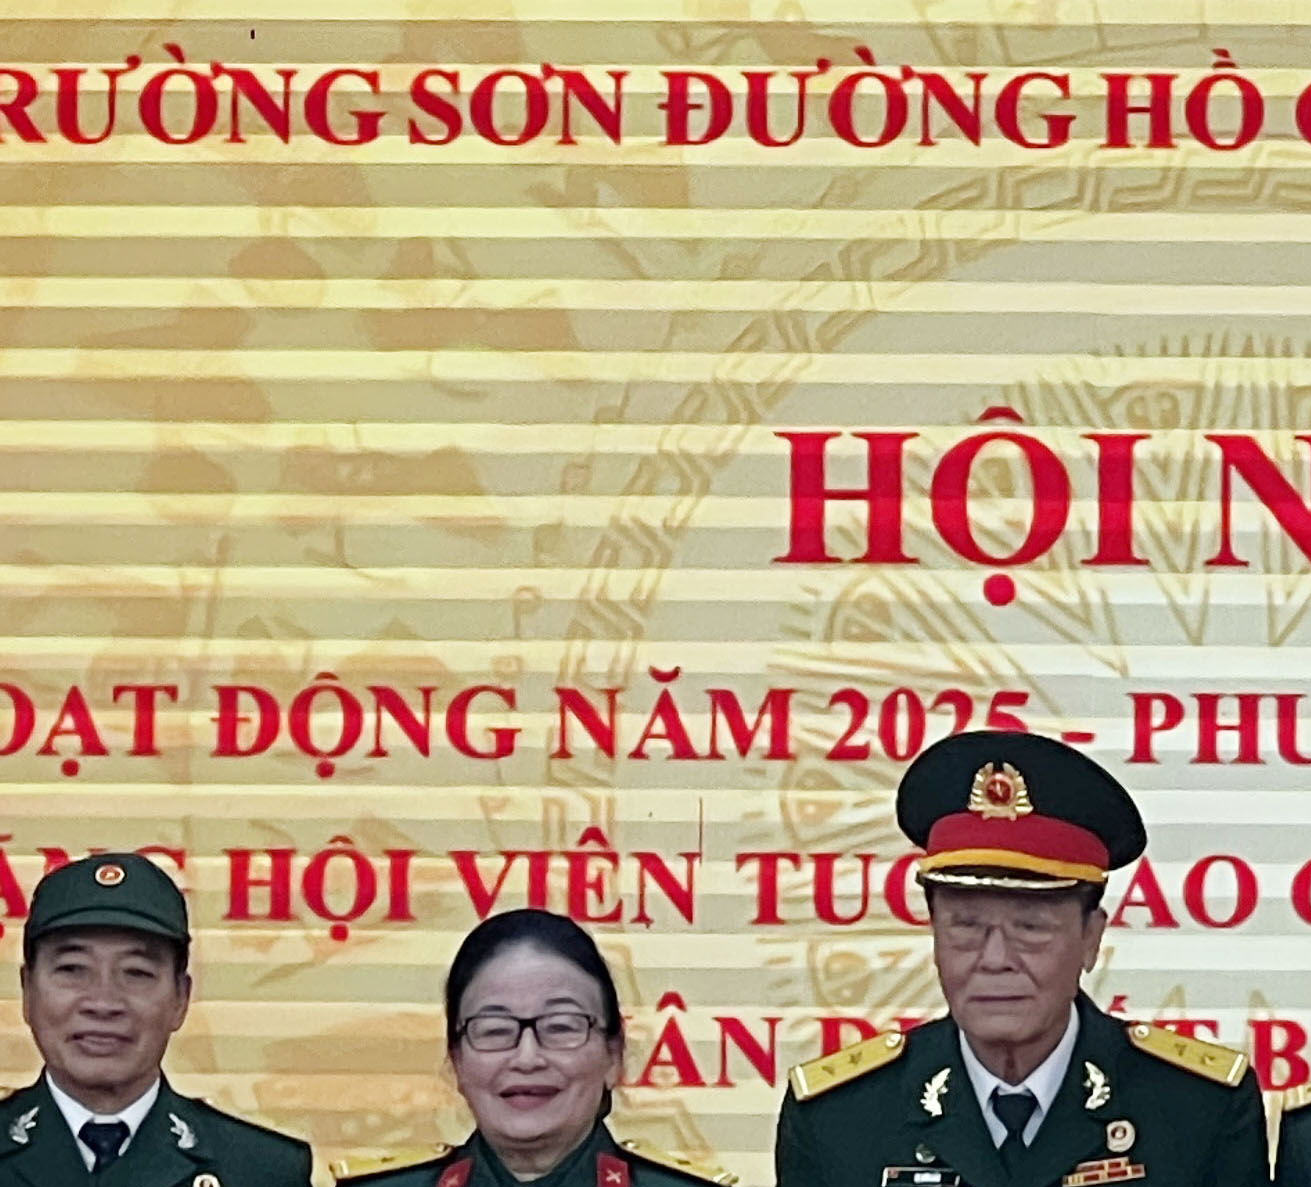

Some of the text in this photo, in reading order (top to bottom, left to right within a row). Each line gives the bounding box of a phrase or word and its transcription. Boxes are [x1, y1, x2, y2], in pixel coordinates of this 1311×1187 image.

[408, 63, 627, 146] SƠN
[659, 47, 1075, 149] ĐƯỜNG
[1103, 49, 1265, 151] HỒ
[773, 406, 1149, 607] HỘI
[211, 672, 521, 779] ĐỘNG
[554, 667, 795, 761] NĂM
[224, 835, 416, 943] HỘI
[448, 825, 701, 926] VIÊN
